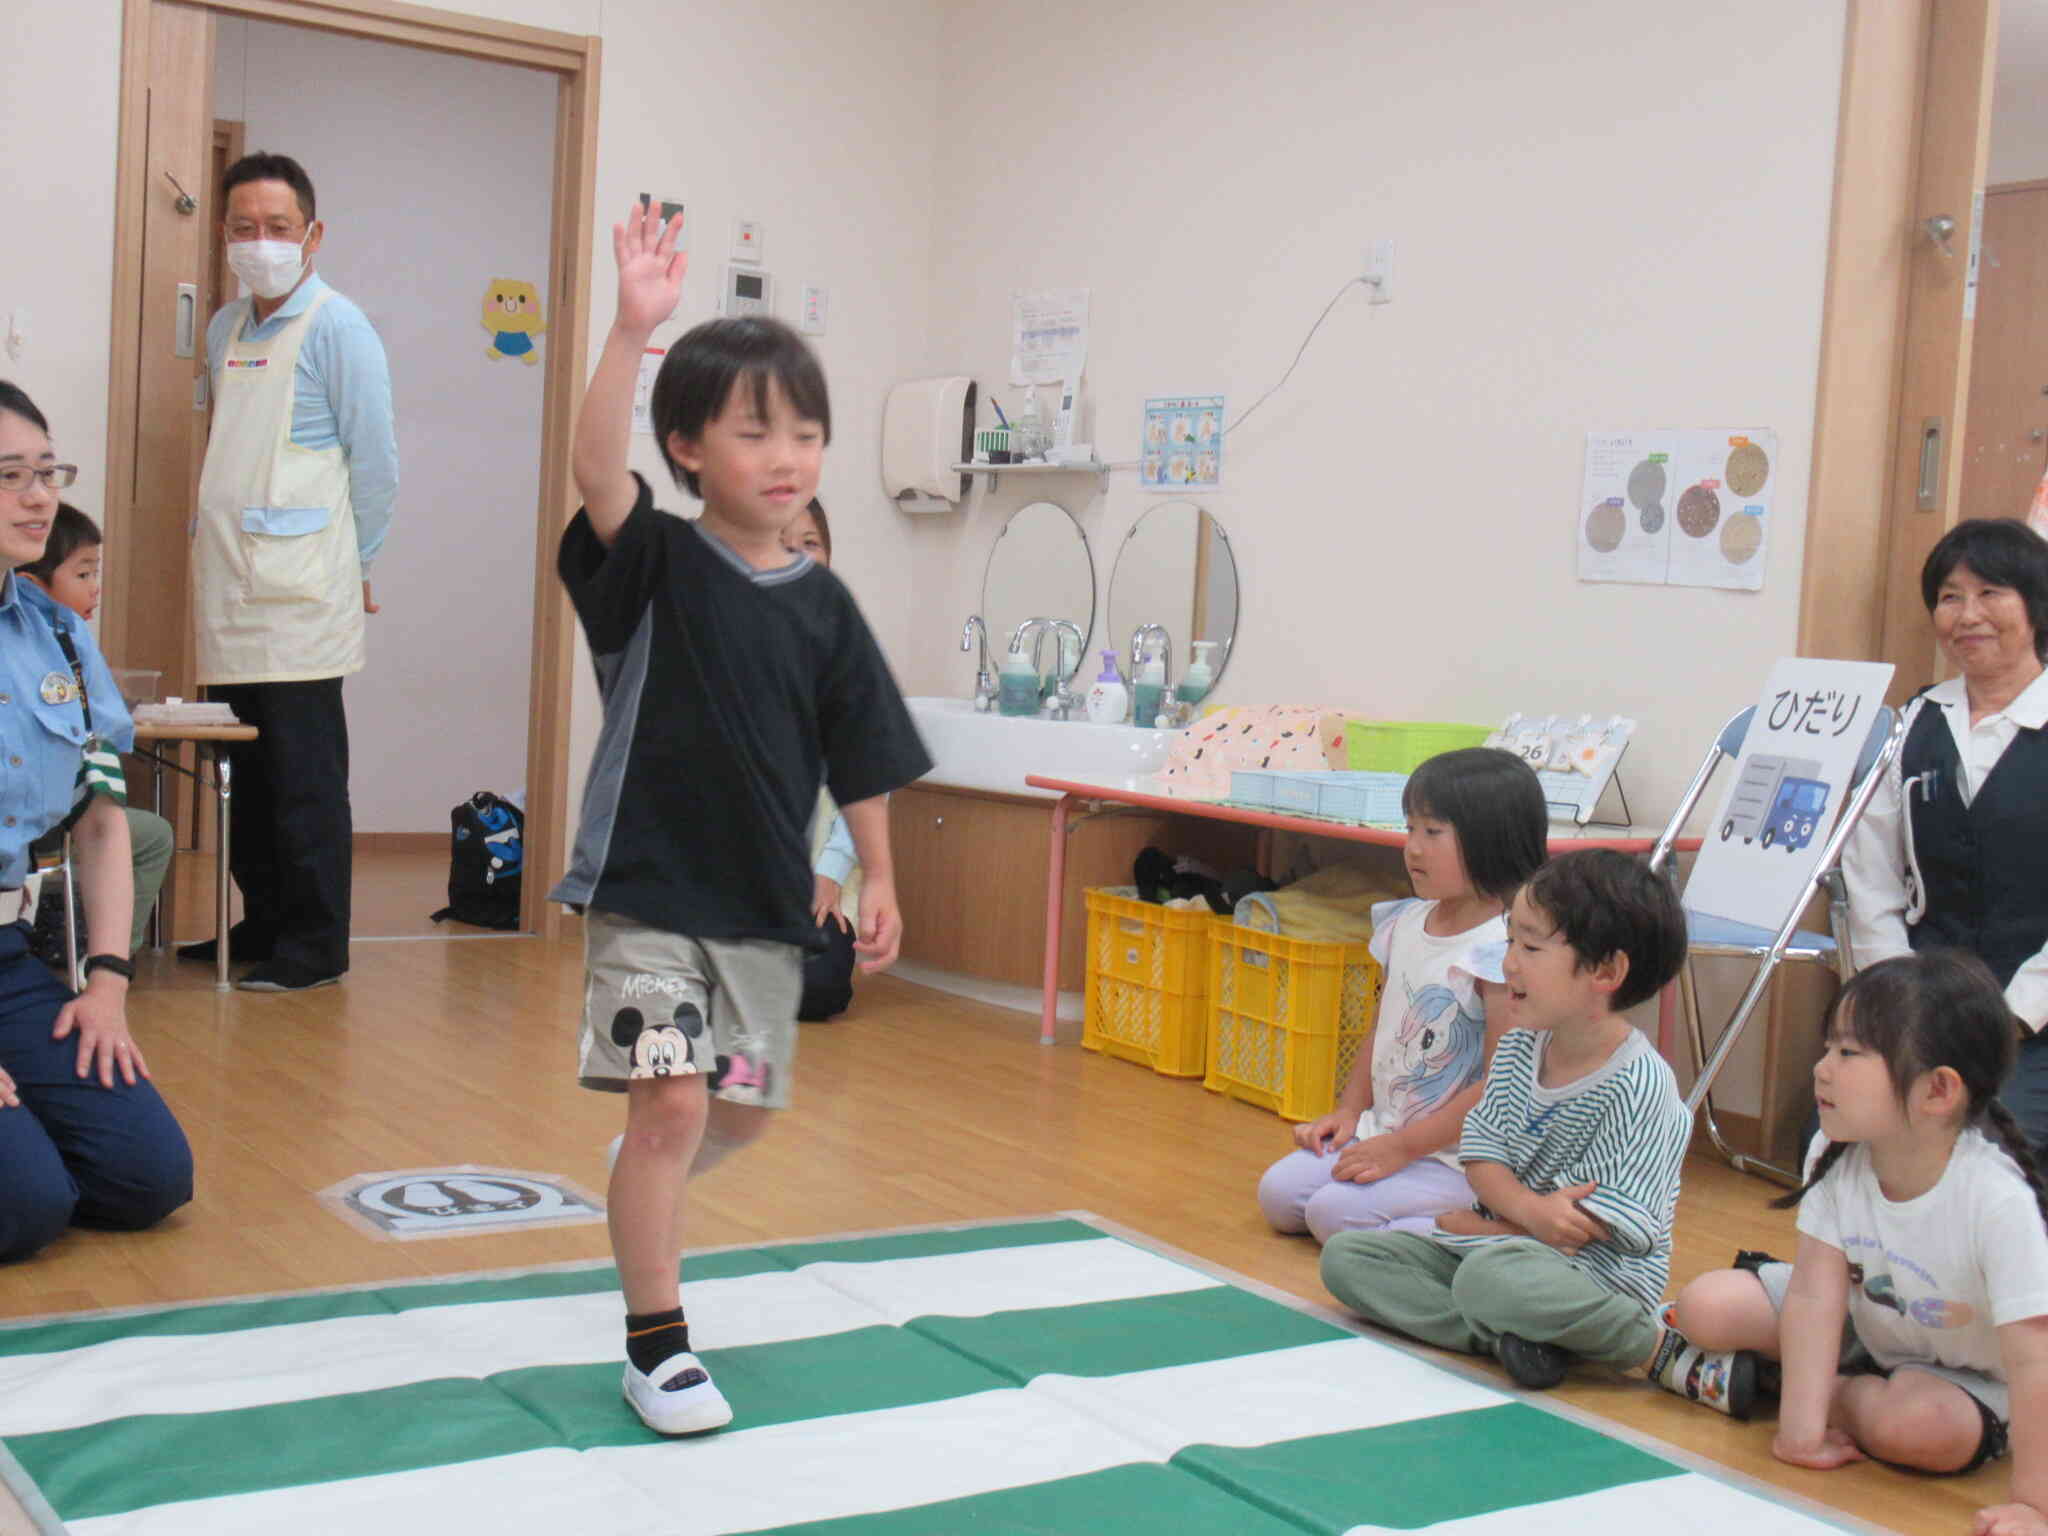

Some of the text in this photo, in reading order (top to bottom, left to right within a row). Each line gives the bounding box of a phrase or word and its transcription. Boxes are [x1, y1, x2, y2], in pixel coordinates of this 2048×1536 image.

[1768, 689, 1861, 737] ひだり
[1521, 745, 1543, 761] 26
